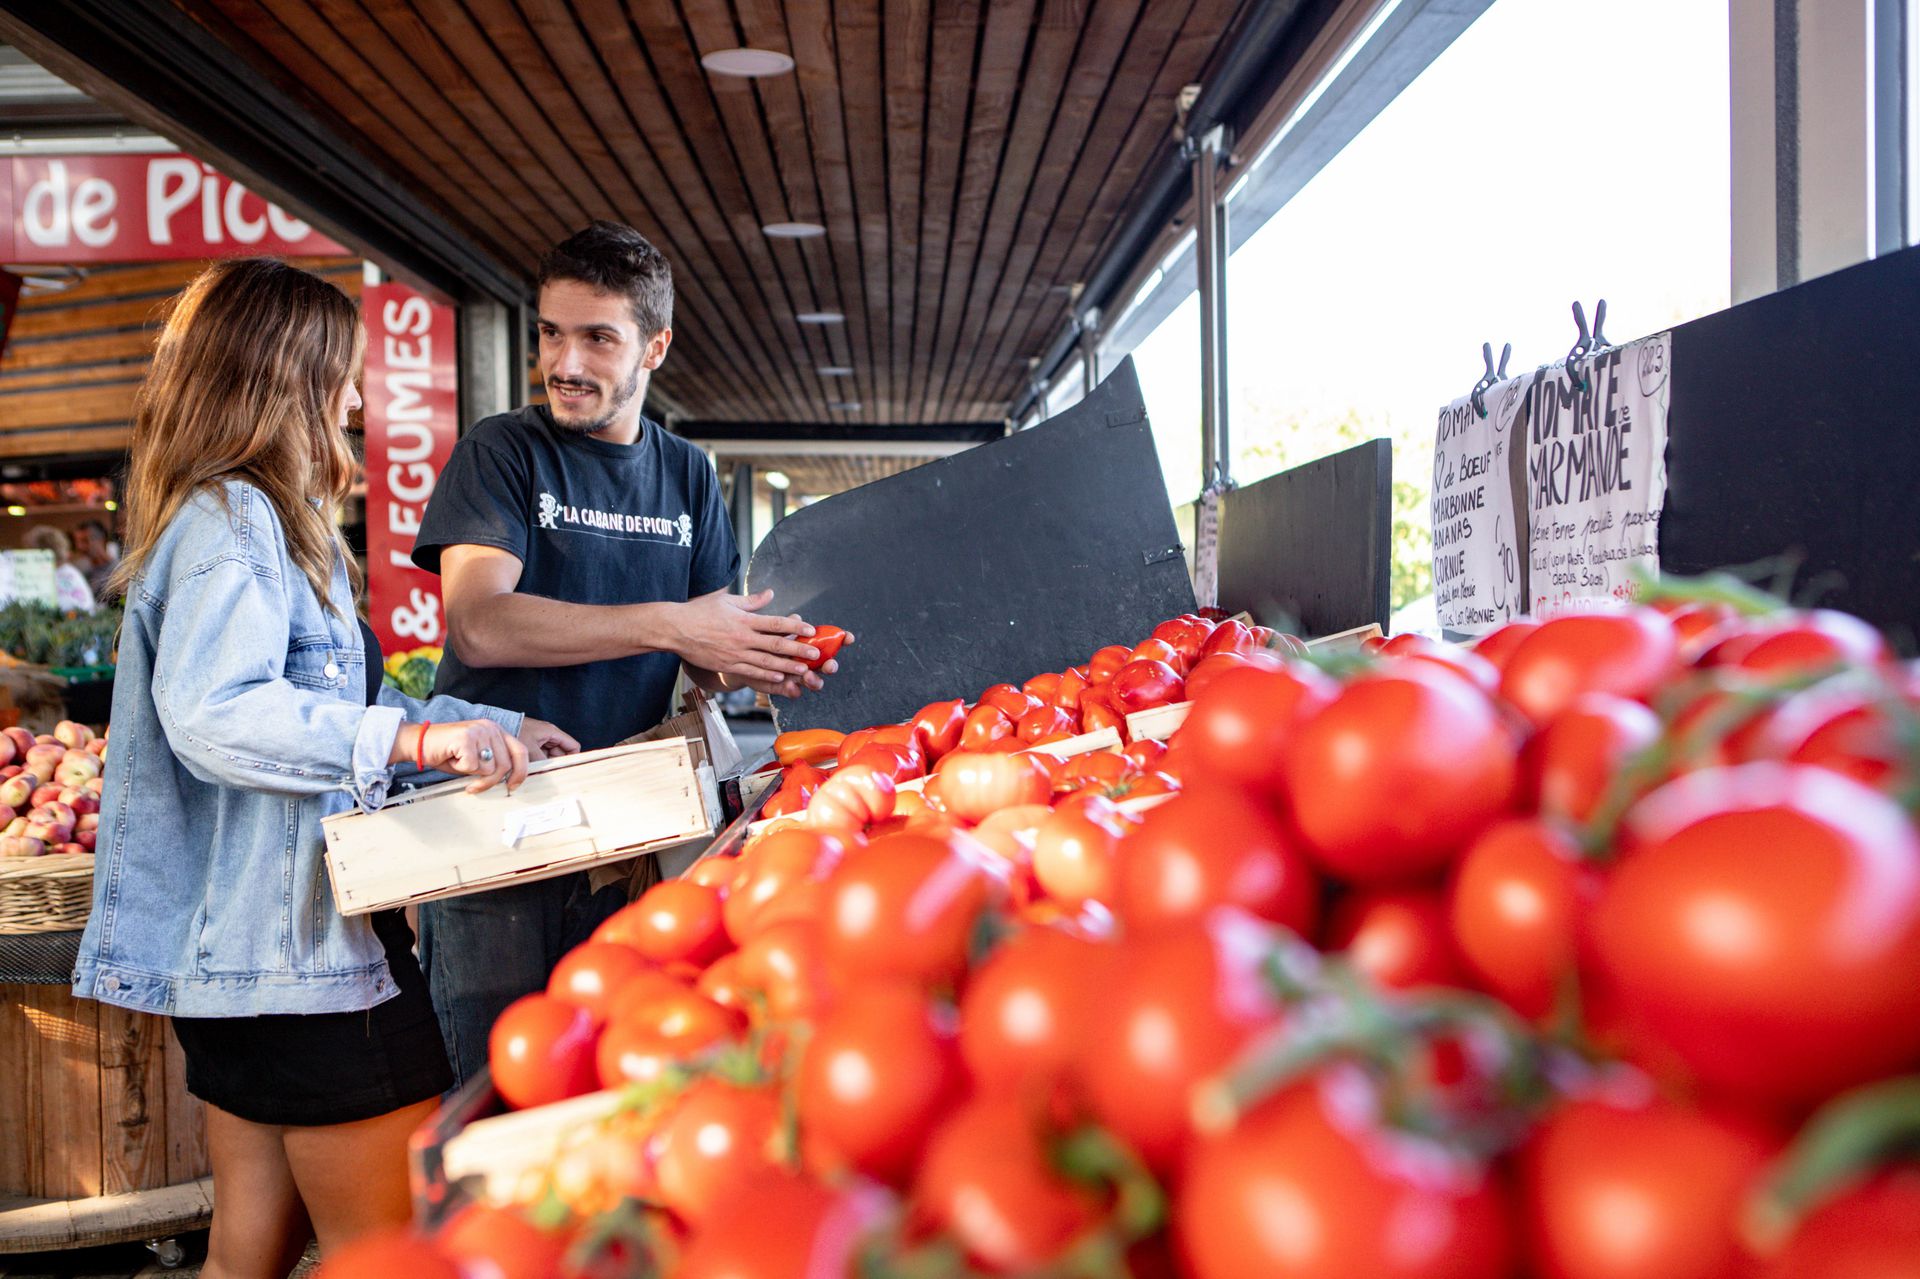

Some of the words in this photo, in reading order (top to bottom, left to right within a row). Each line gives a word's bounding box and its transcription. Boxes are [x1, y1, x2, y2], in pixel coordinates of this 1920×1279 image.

[23, 158, 119, 247] de
[1531, 348, 1625, 445] TOMATE
[563, 506, 581, 524] LA
[581, 509, 625, 532] CABANE
[625, 515, 642, 533] DE
[643, 517, 674, 537] PICOT
[1433, 517, 1473, 550] ANANAS
[1434, 550, 1465, 586] CORNUE
[391, 588, 440, 643] &
